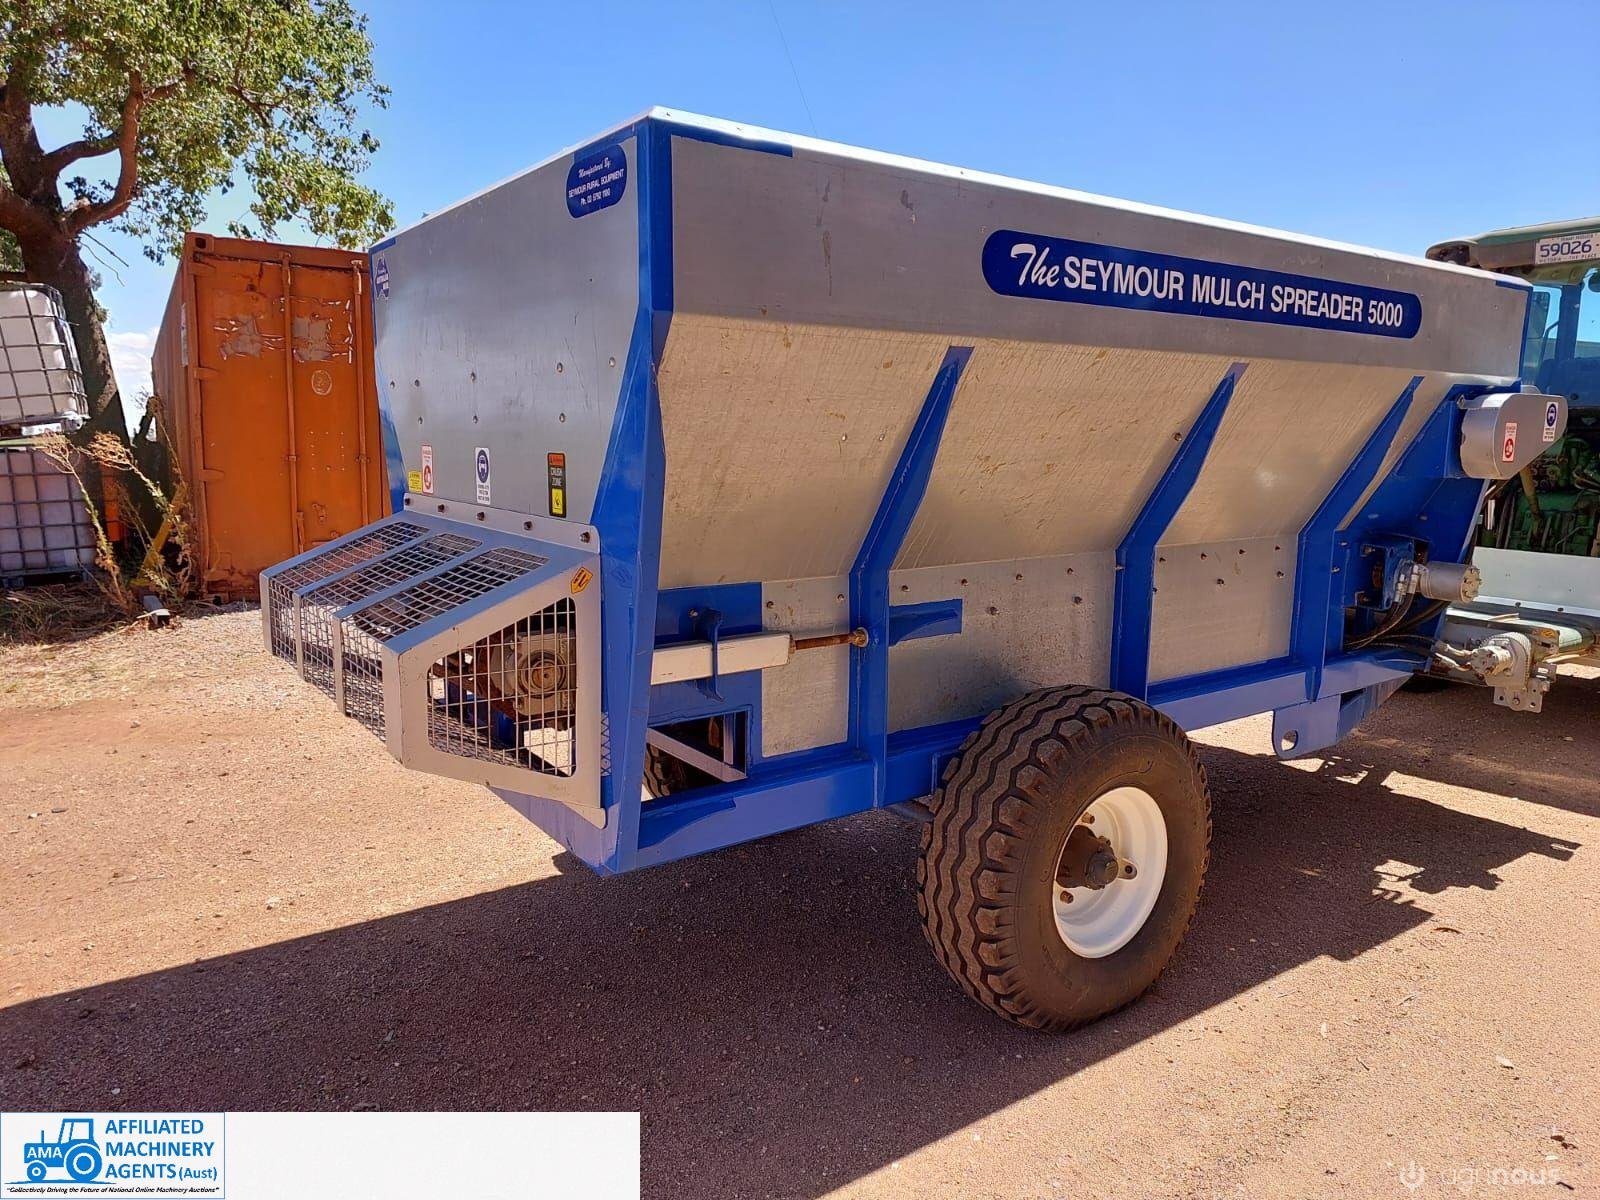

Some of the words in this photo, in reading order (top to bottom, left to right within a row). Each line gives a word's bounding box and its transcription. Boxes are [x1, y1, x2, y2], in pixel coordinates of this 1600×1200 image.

[568, 184, 587, 198] SEYMOUR
[601, 168, 624, 185] EQUIPMENT
[1540, 240, 1592, 257] 59026
[1010, 243, 1060, 287] The
[1064, 255, 1185, 301] SEYMOUR
[1191, 273, 1265, 310] MULCH
[1270, 284, 1363, 323] SPREADER
[1367, 300, 1403, 328] 5000
